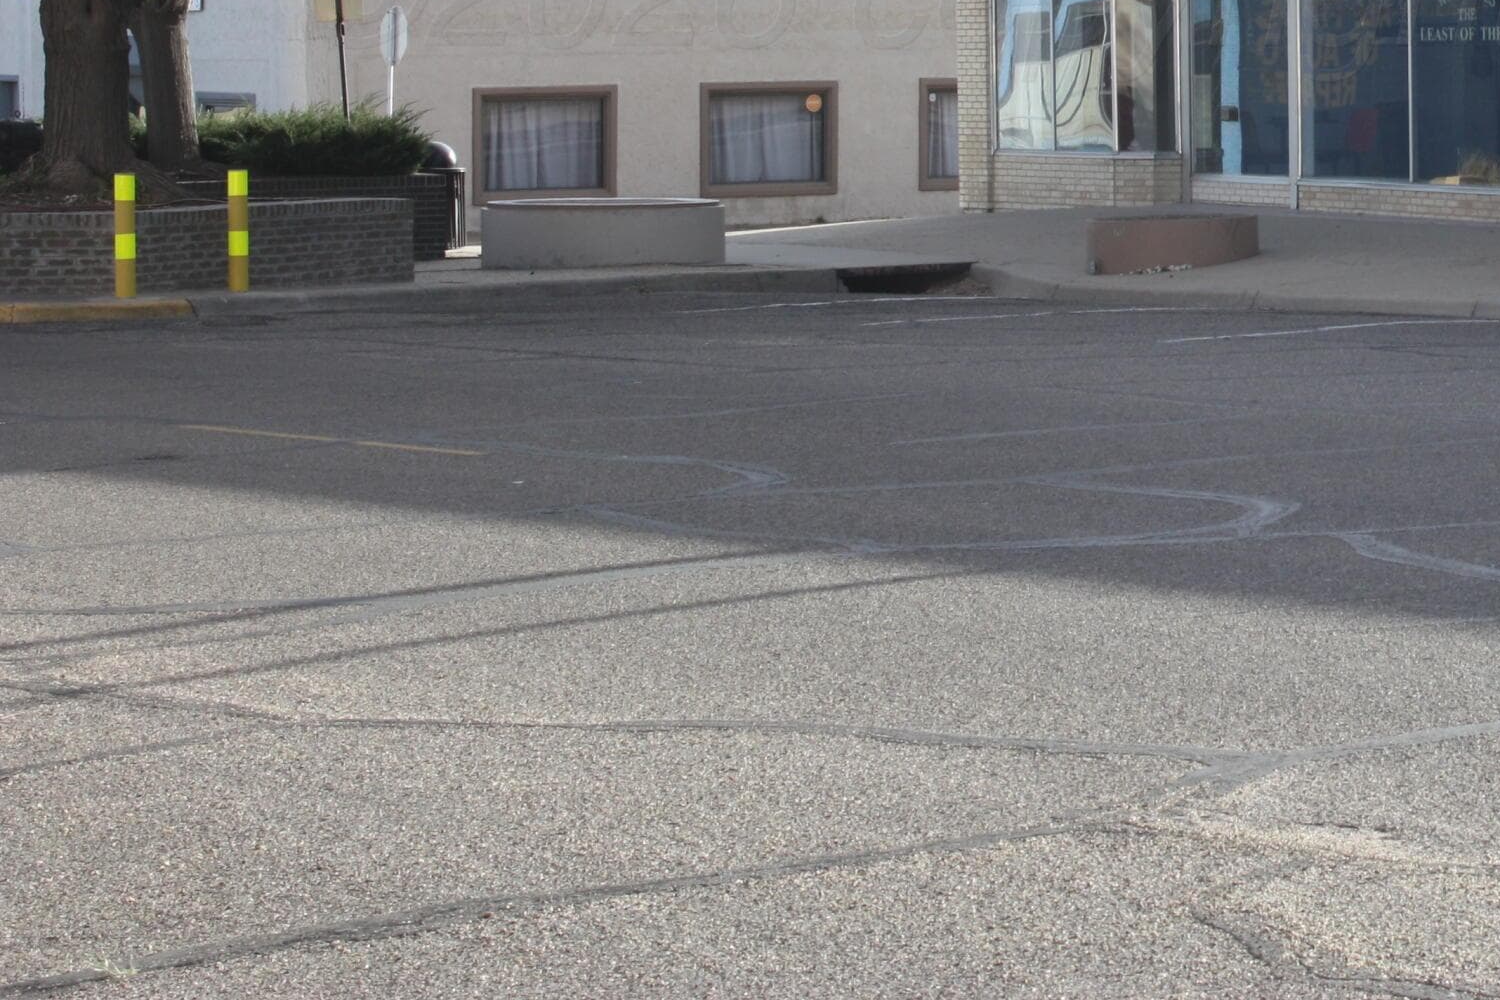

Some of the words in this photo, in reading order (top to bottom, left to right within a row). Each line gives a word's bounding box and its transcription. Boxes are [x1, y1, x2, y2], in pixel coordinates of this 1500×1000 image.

[1458, 8, 1477, 21] THE
[1420, 27, 1455, 41] LEAST
[1460, 27, 1476, 40] OF
